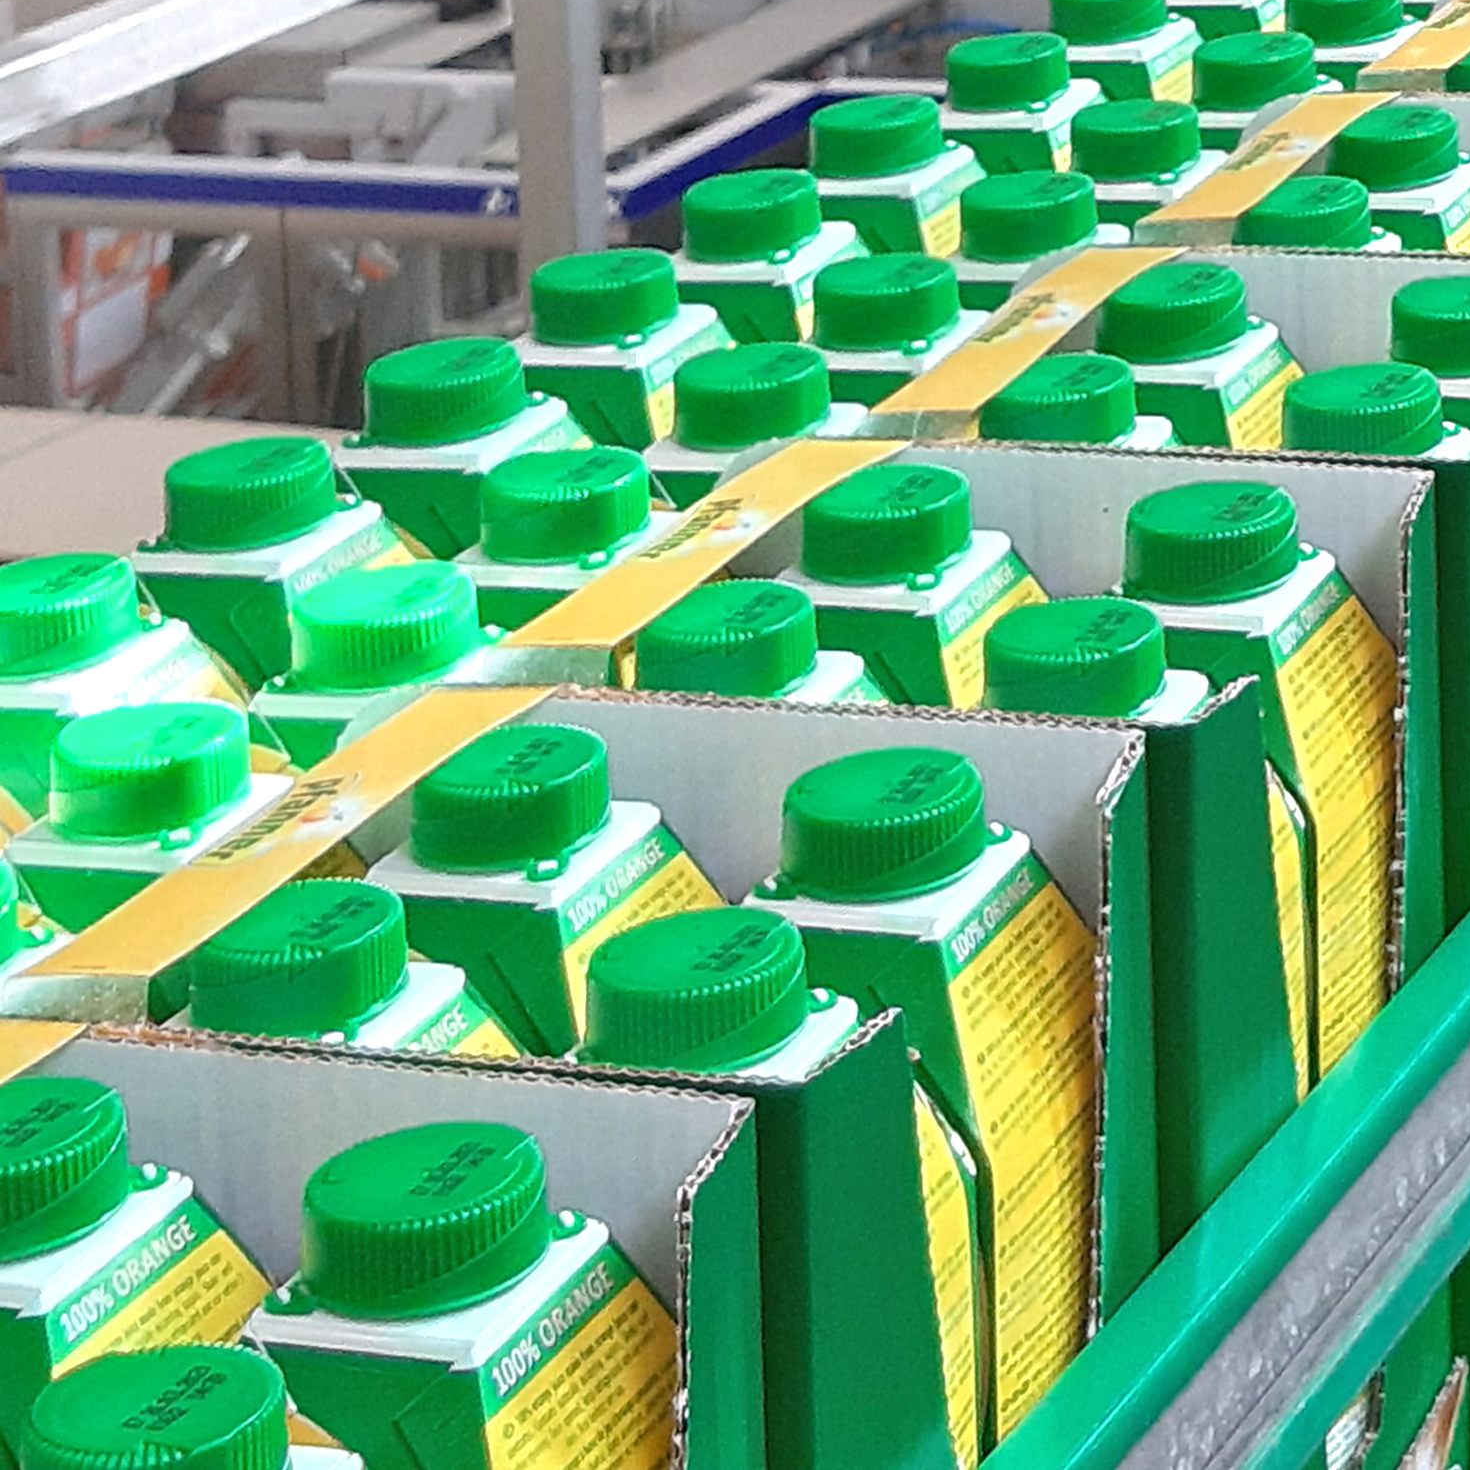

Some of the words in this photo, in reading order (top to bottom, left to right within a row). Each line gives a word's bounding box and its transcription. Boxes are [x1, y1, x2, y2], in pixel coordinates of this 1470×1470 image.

[203, 776, 345, 861] pfanner
[604, 835, 667, 900] ORANGE
[58, 1285, 116, 1344] 100%
[111, 1213, 198, 1298] ORANGE
[490, 1331, 542, 1398] 100%
[537, 1260, 616, 1349] ORANGE
